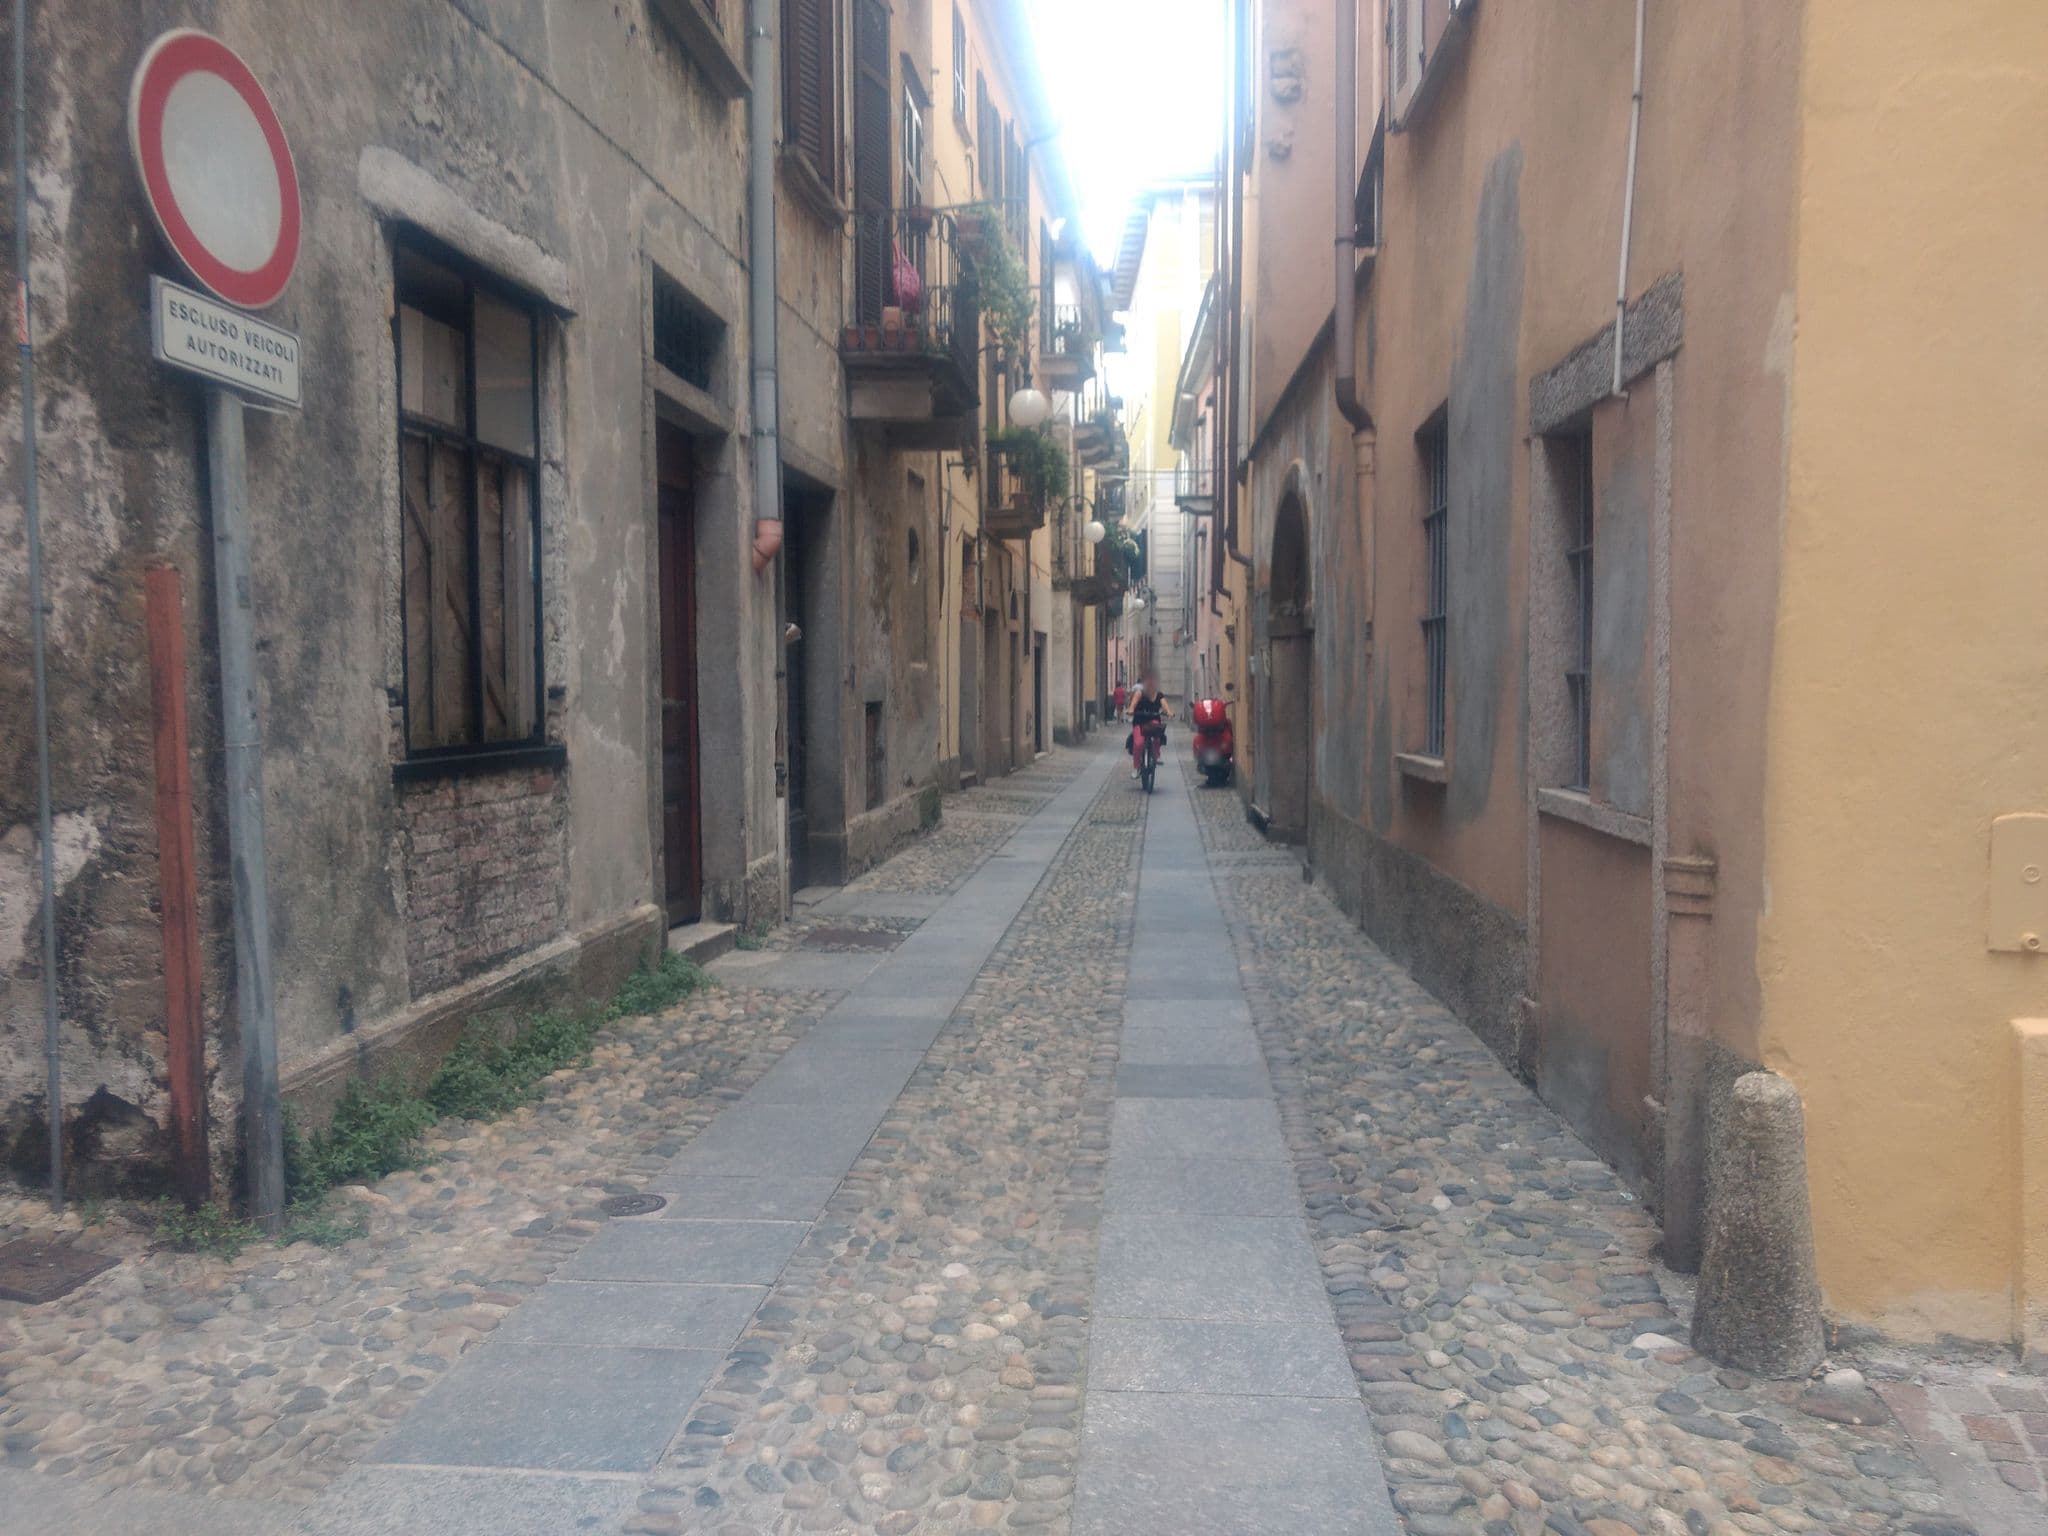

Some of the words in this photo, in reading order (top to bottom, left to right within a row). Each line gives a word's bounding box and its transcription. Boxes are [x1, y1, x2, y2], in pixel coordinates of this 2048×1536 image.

[168, 300, 238, 340] ESCLUSO
[244, 329, 294, 363] VEICOLI
[186, 334, 283, 384] AUTORIZZATI
